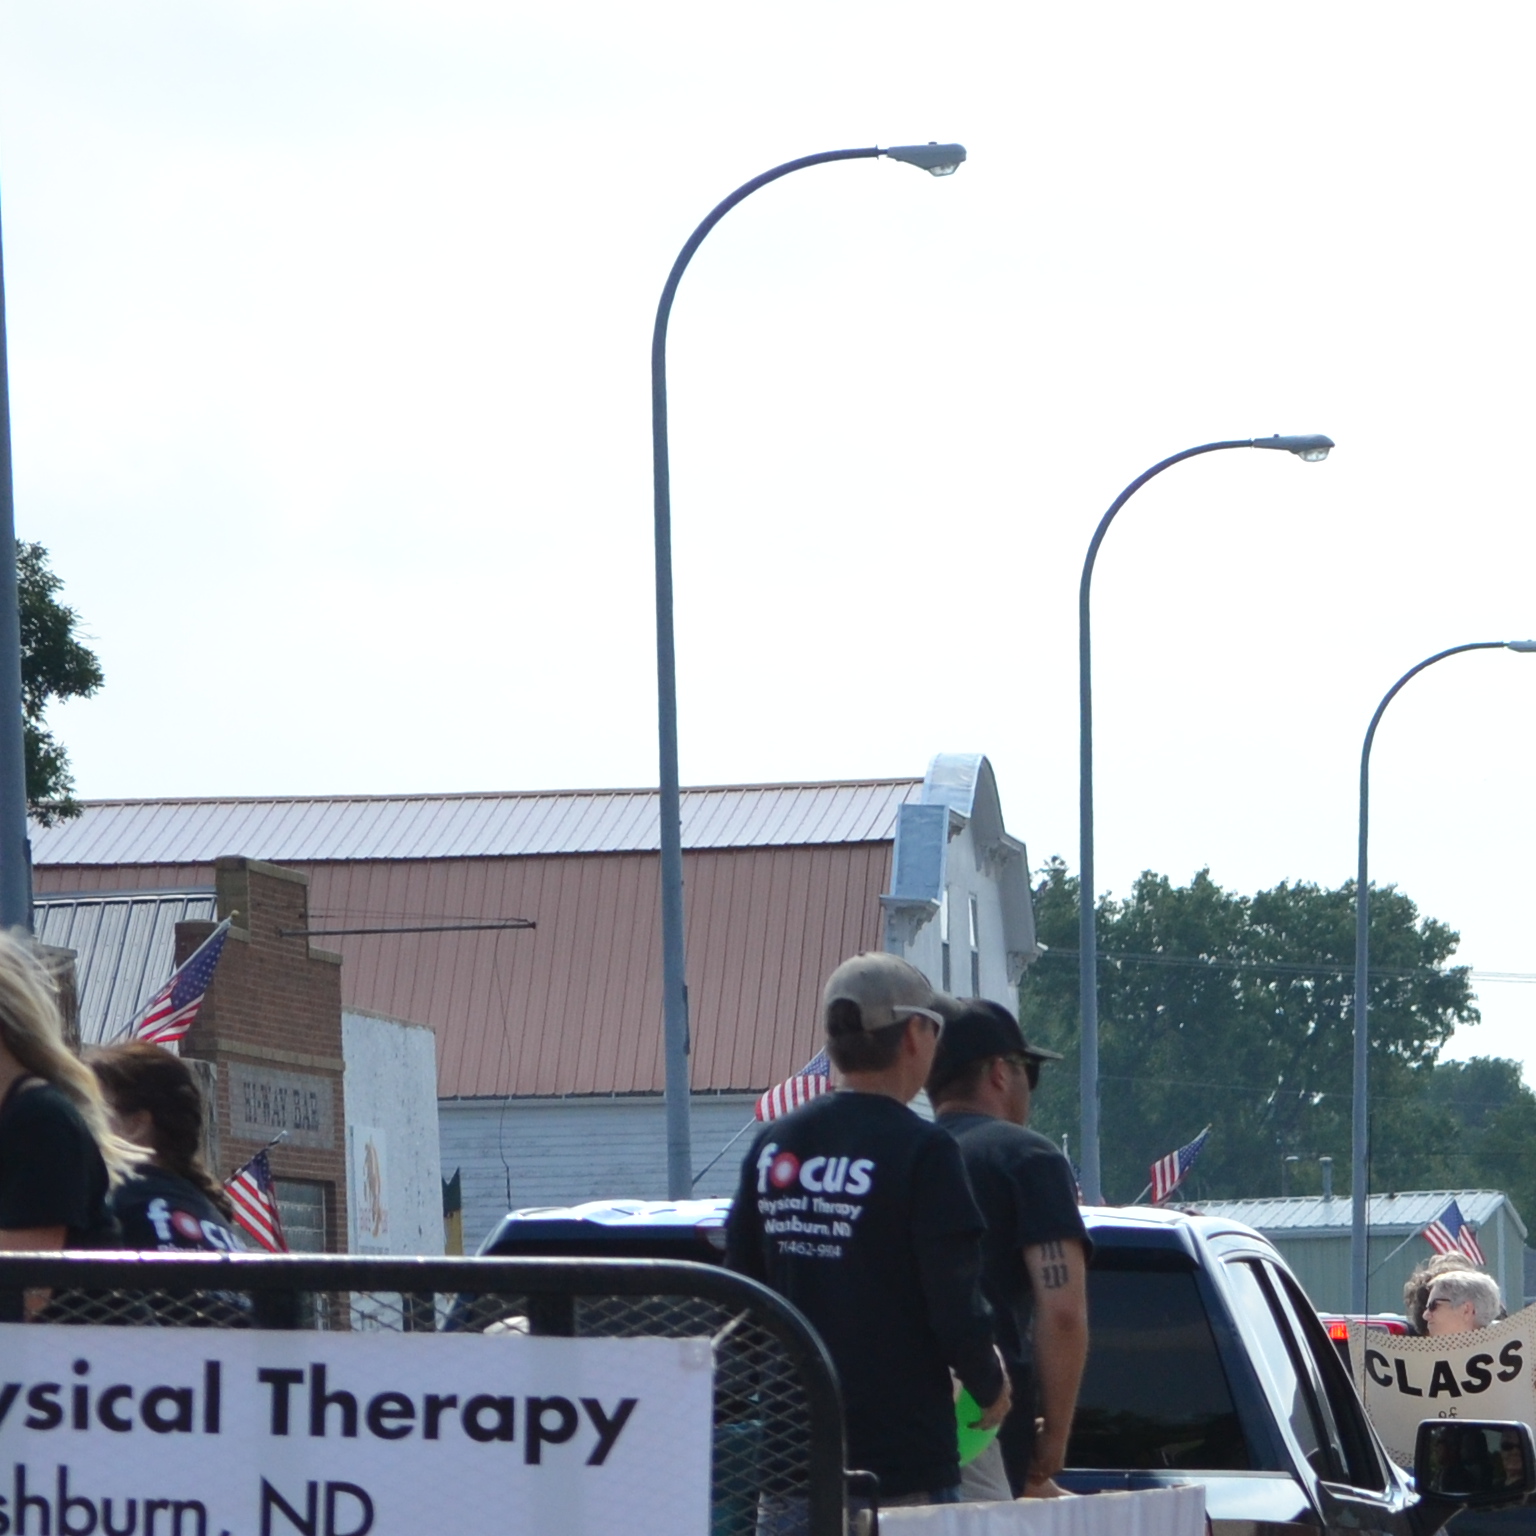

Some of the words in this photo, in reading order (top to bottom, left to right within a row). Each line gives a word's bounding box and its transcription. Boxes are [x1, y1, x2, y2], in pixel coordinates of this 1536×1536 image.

[243, 1081, 288, 1128] HI-WAY
[292, 1088, 320, 1132] BAR
[756, 1142, 876, 1195] focus
[146, 1197, 248, 1253] focu
[1364, 1339, 1524, 1399] CLASS
[257, 1362, 640, 1466] Therapy
